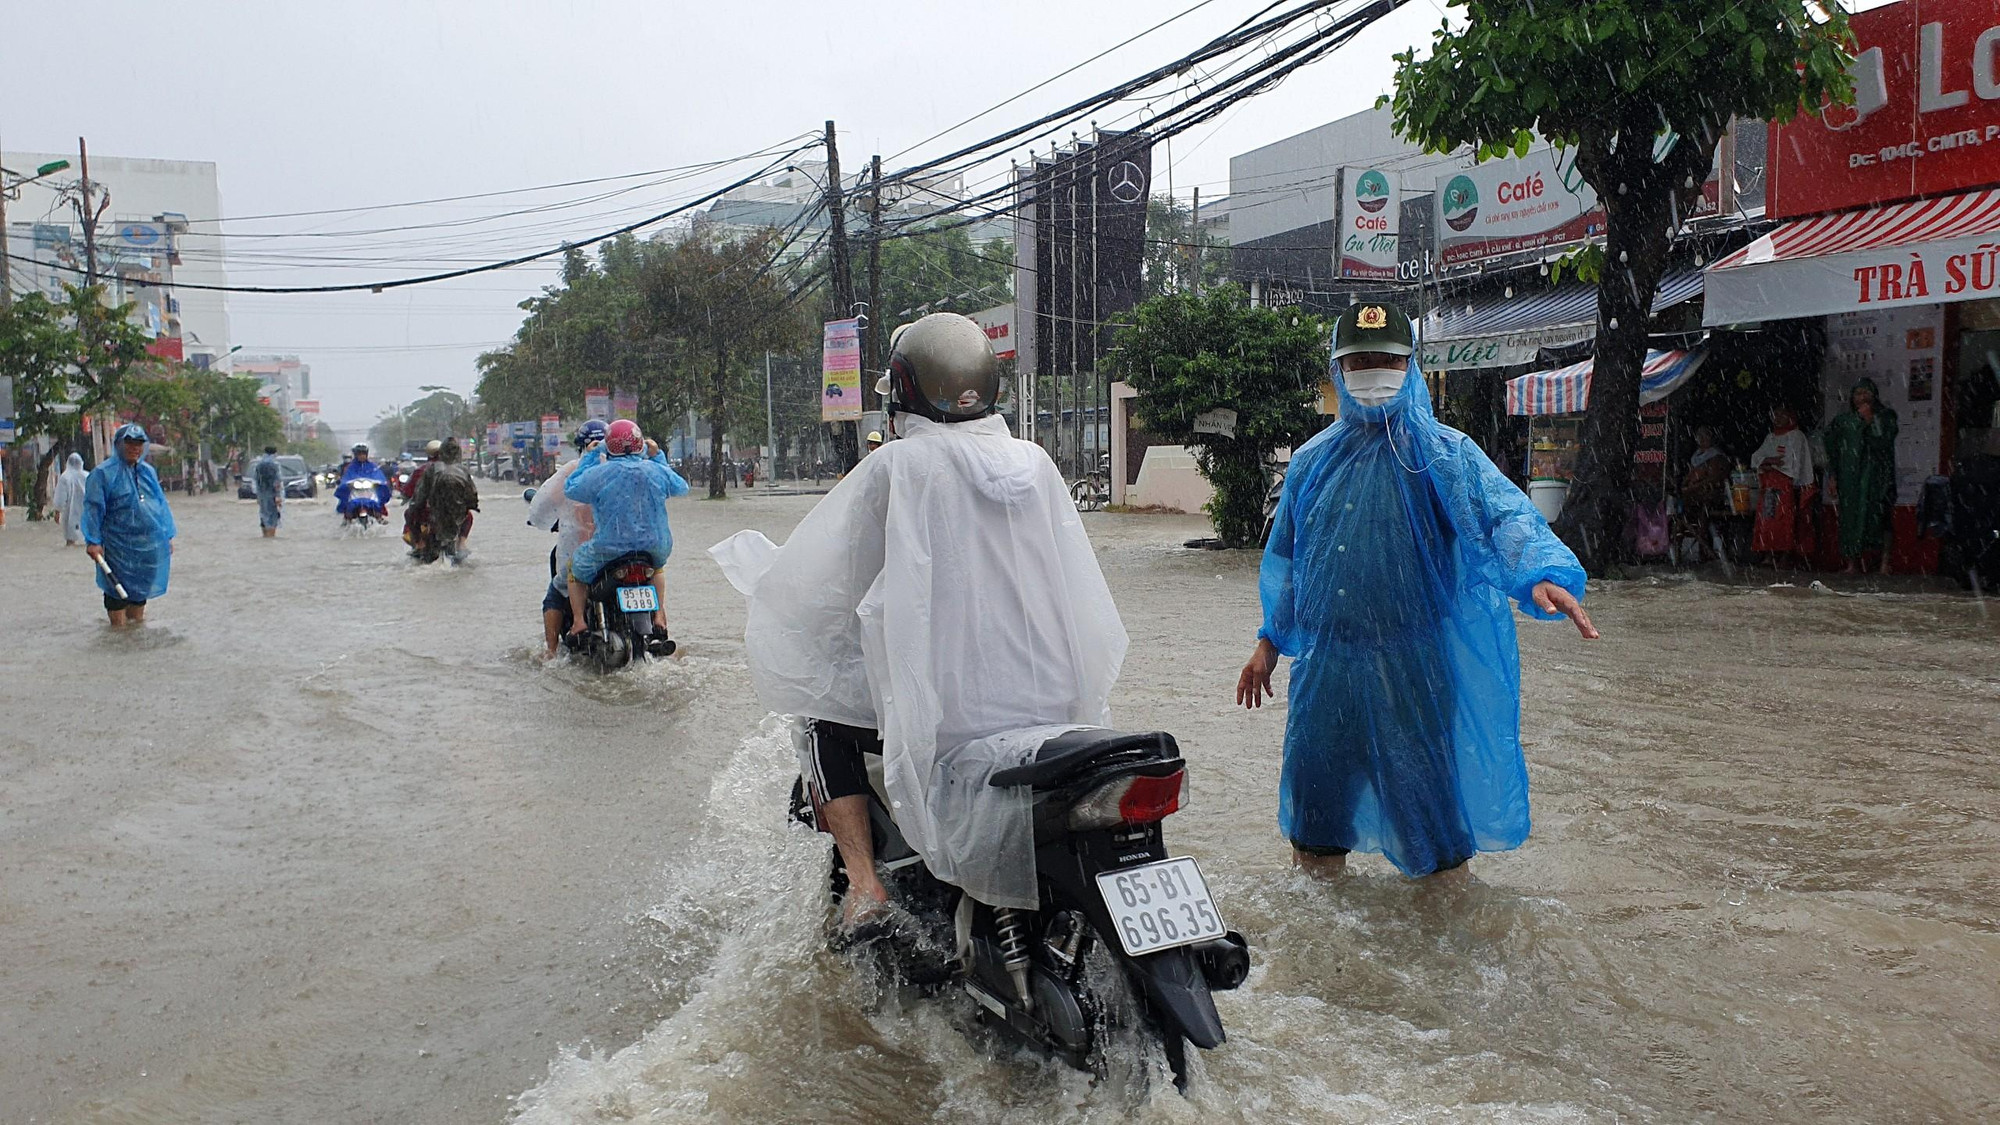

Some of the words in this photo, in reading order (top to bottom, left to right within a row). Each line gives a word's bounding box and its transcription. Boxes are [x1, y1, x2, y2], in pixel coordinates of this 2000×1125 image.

[1879, 141, 1925, 162] 104C,
[1927, 129, 1982, 152] CMT8,
[1497, 171, 1545, 204] Café
[1355, 215, 1388, 231] Café
[1344, 233, 1365, 252] Gu
[1854, 252, 1929, 303] TRÀ
[1945, 242, 2000, 294] SỮ
[1447, 342, 1500, 366] Việt
[626, 599, 653, 610] 4389
[1119, 851, 1151, 863] HONDA
[1115, 864, 1192, 908] 65-B1
[1121, 898, 1218, 948] 696.35
